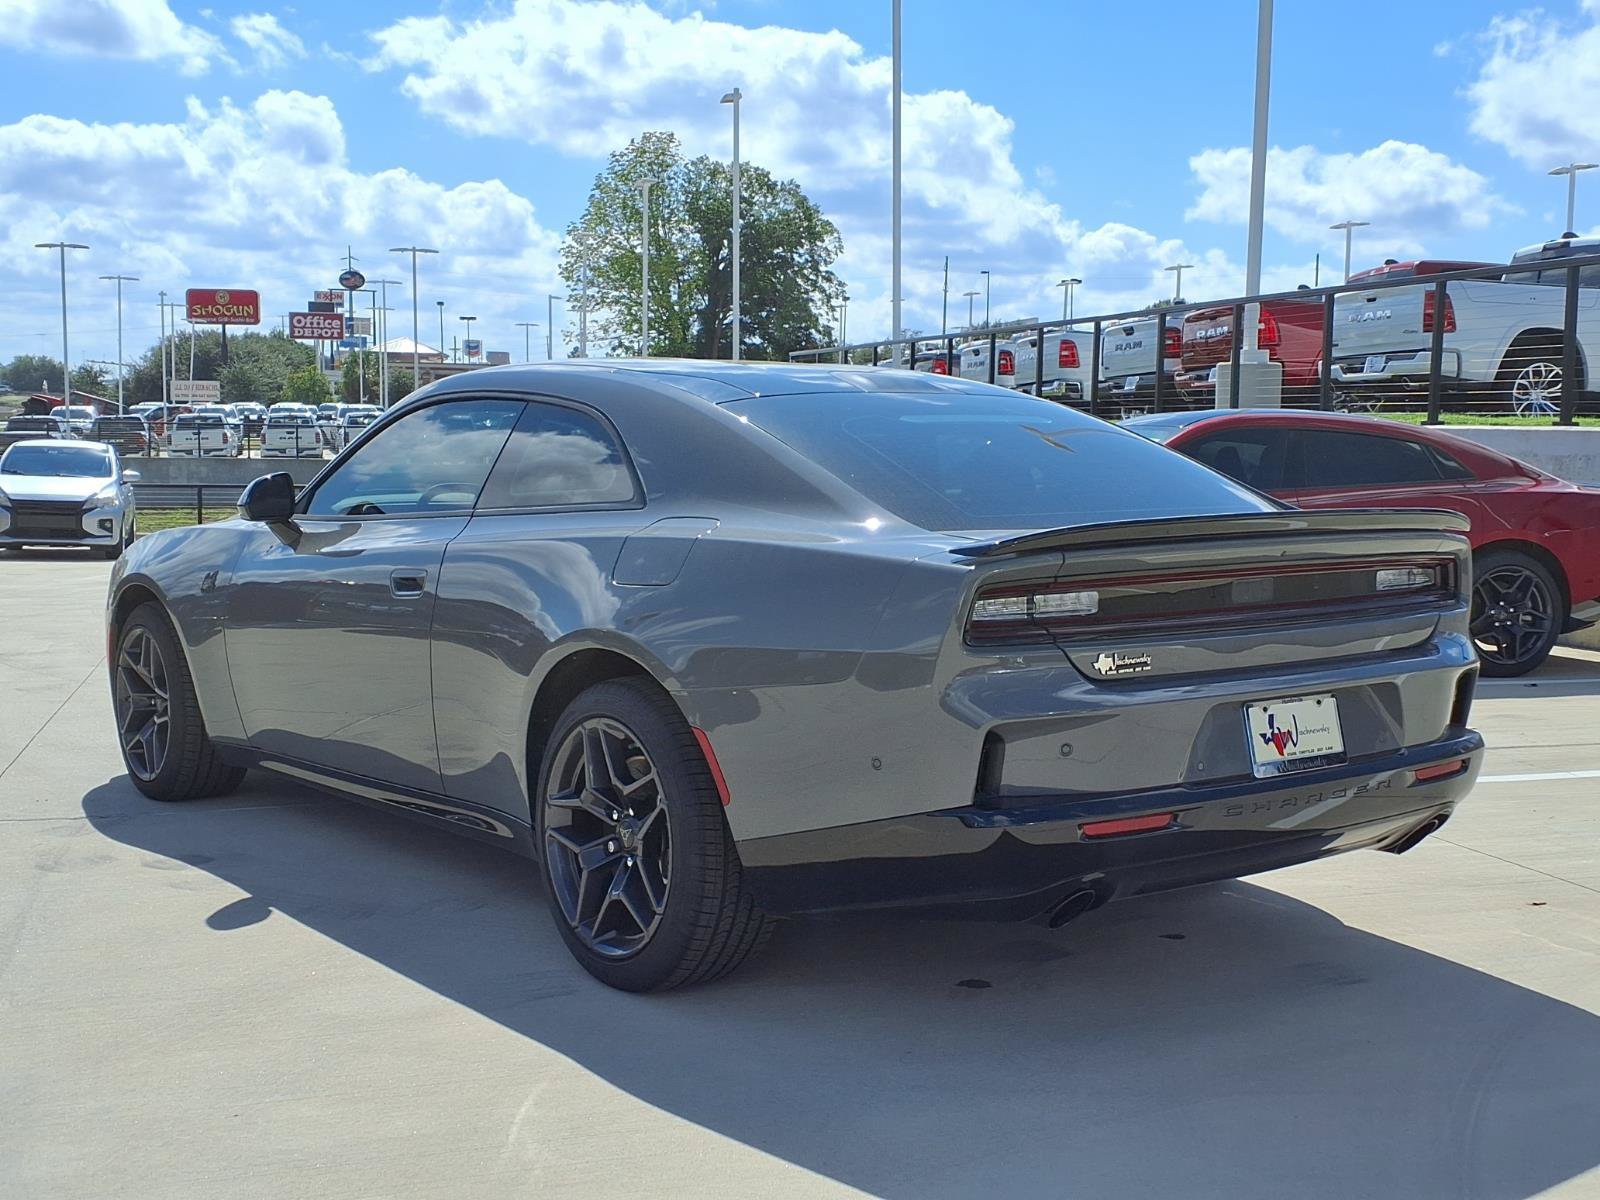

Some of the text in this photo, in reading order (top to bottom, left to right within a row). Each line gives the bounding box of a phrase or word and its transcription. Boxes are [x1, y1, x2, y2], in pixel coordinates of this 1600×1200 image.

[191, 304, 254, 316] SHOGUN
[1347, 309, 1392, 323] RAM
[292, 315, 341, 328] Office
[293, 328, 341, 337] DEPOT
[1196, 326, 1229, 338] RAM
[1115, 341, 1143, 352] RAM
[1223, 779, 1392, 818] CHARGER
